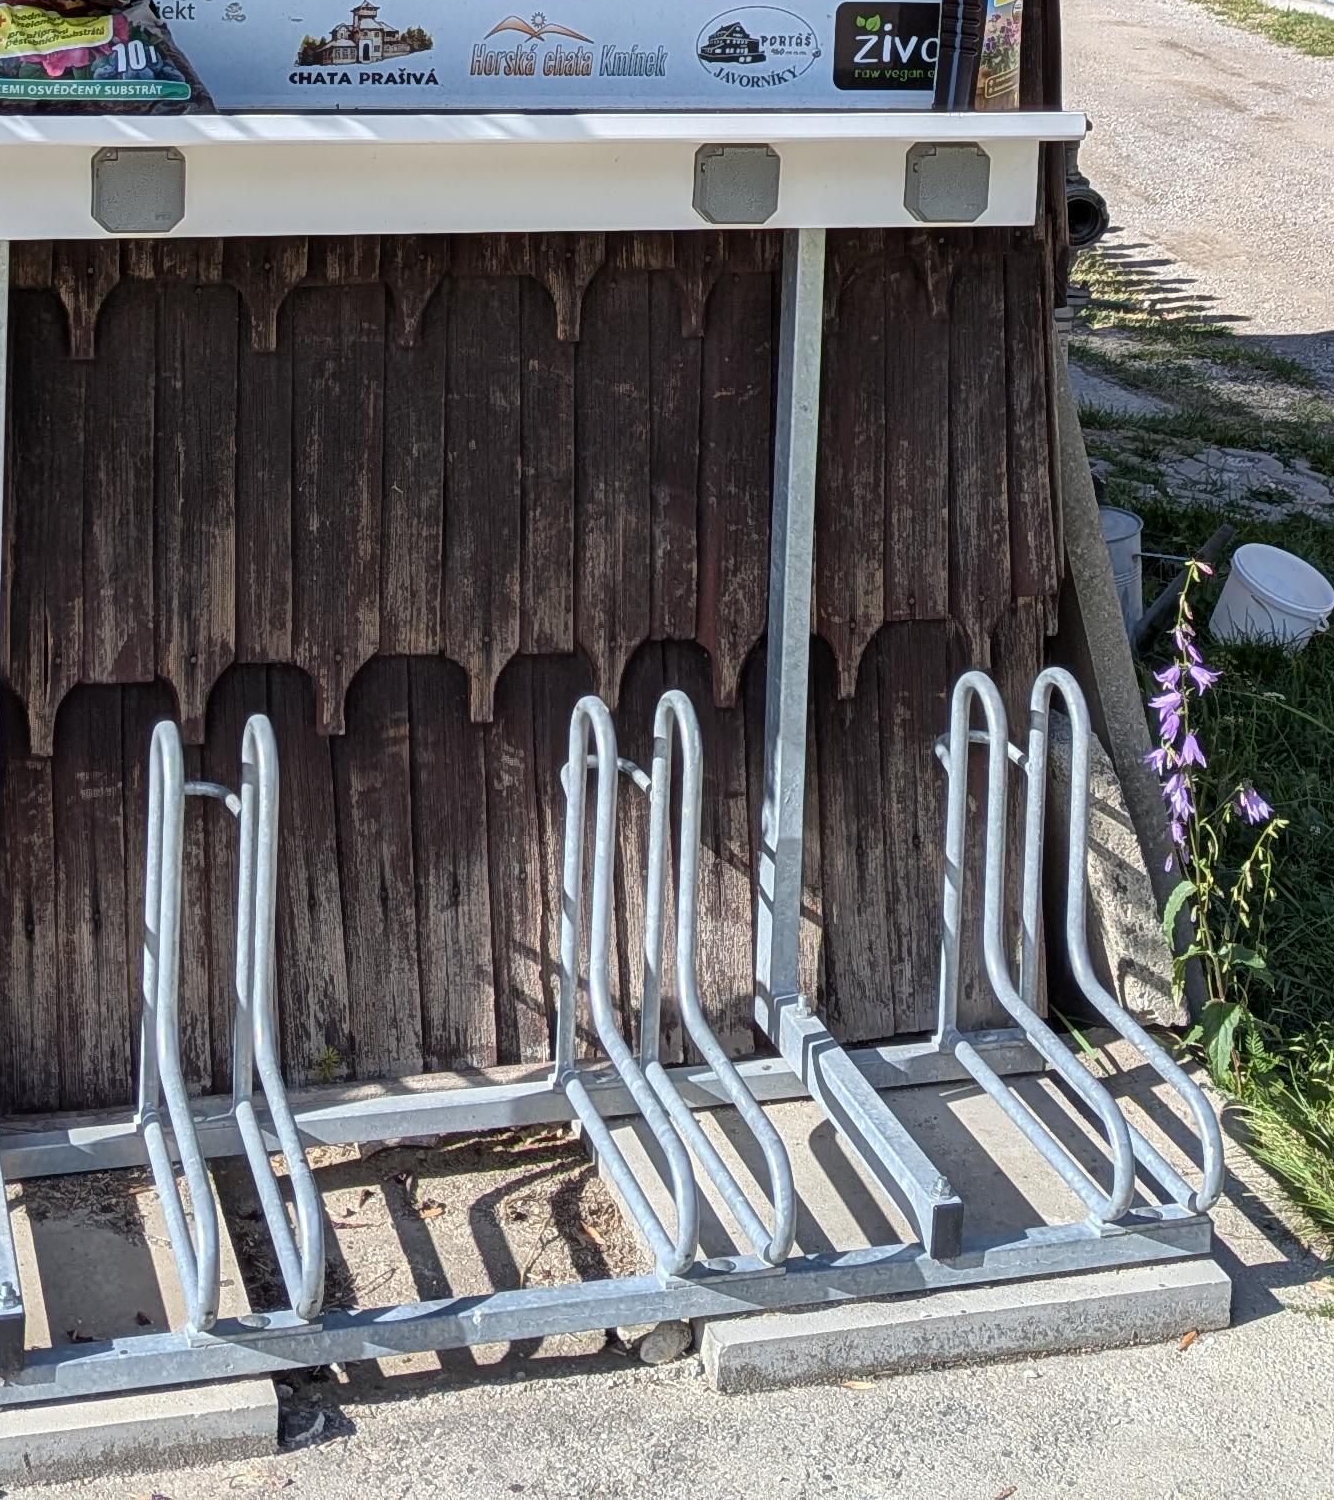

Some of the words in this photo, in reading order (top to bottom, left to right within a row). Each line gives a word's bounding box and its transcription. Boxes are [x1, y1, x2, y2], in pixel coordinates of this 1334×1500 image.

[469, 43, 539, 76] Horská
[542, 44, 594, 77] chata
[598, 44, 669, 78] Kmínek
[288, 71, 352, 85] CHATA
[359, 67, 440, 86] PRAŠIVÁ
[712, 65, 799, 89] JAVORNÍKY
[854, 69, 880, 79] raw
[884, 69, 924, 82] vegan
[27, 82, 101, 96] OSVĚDČENÝ
[104, 83, 163, 96] SUBSTRÁT
